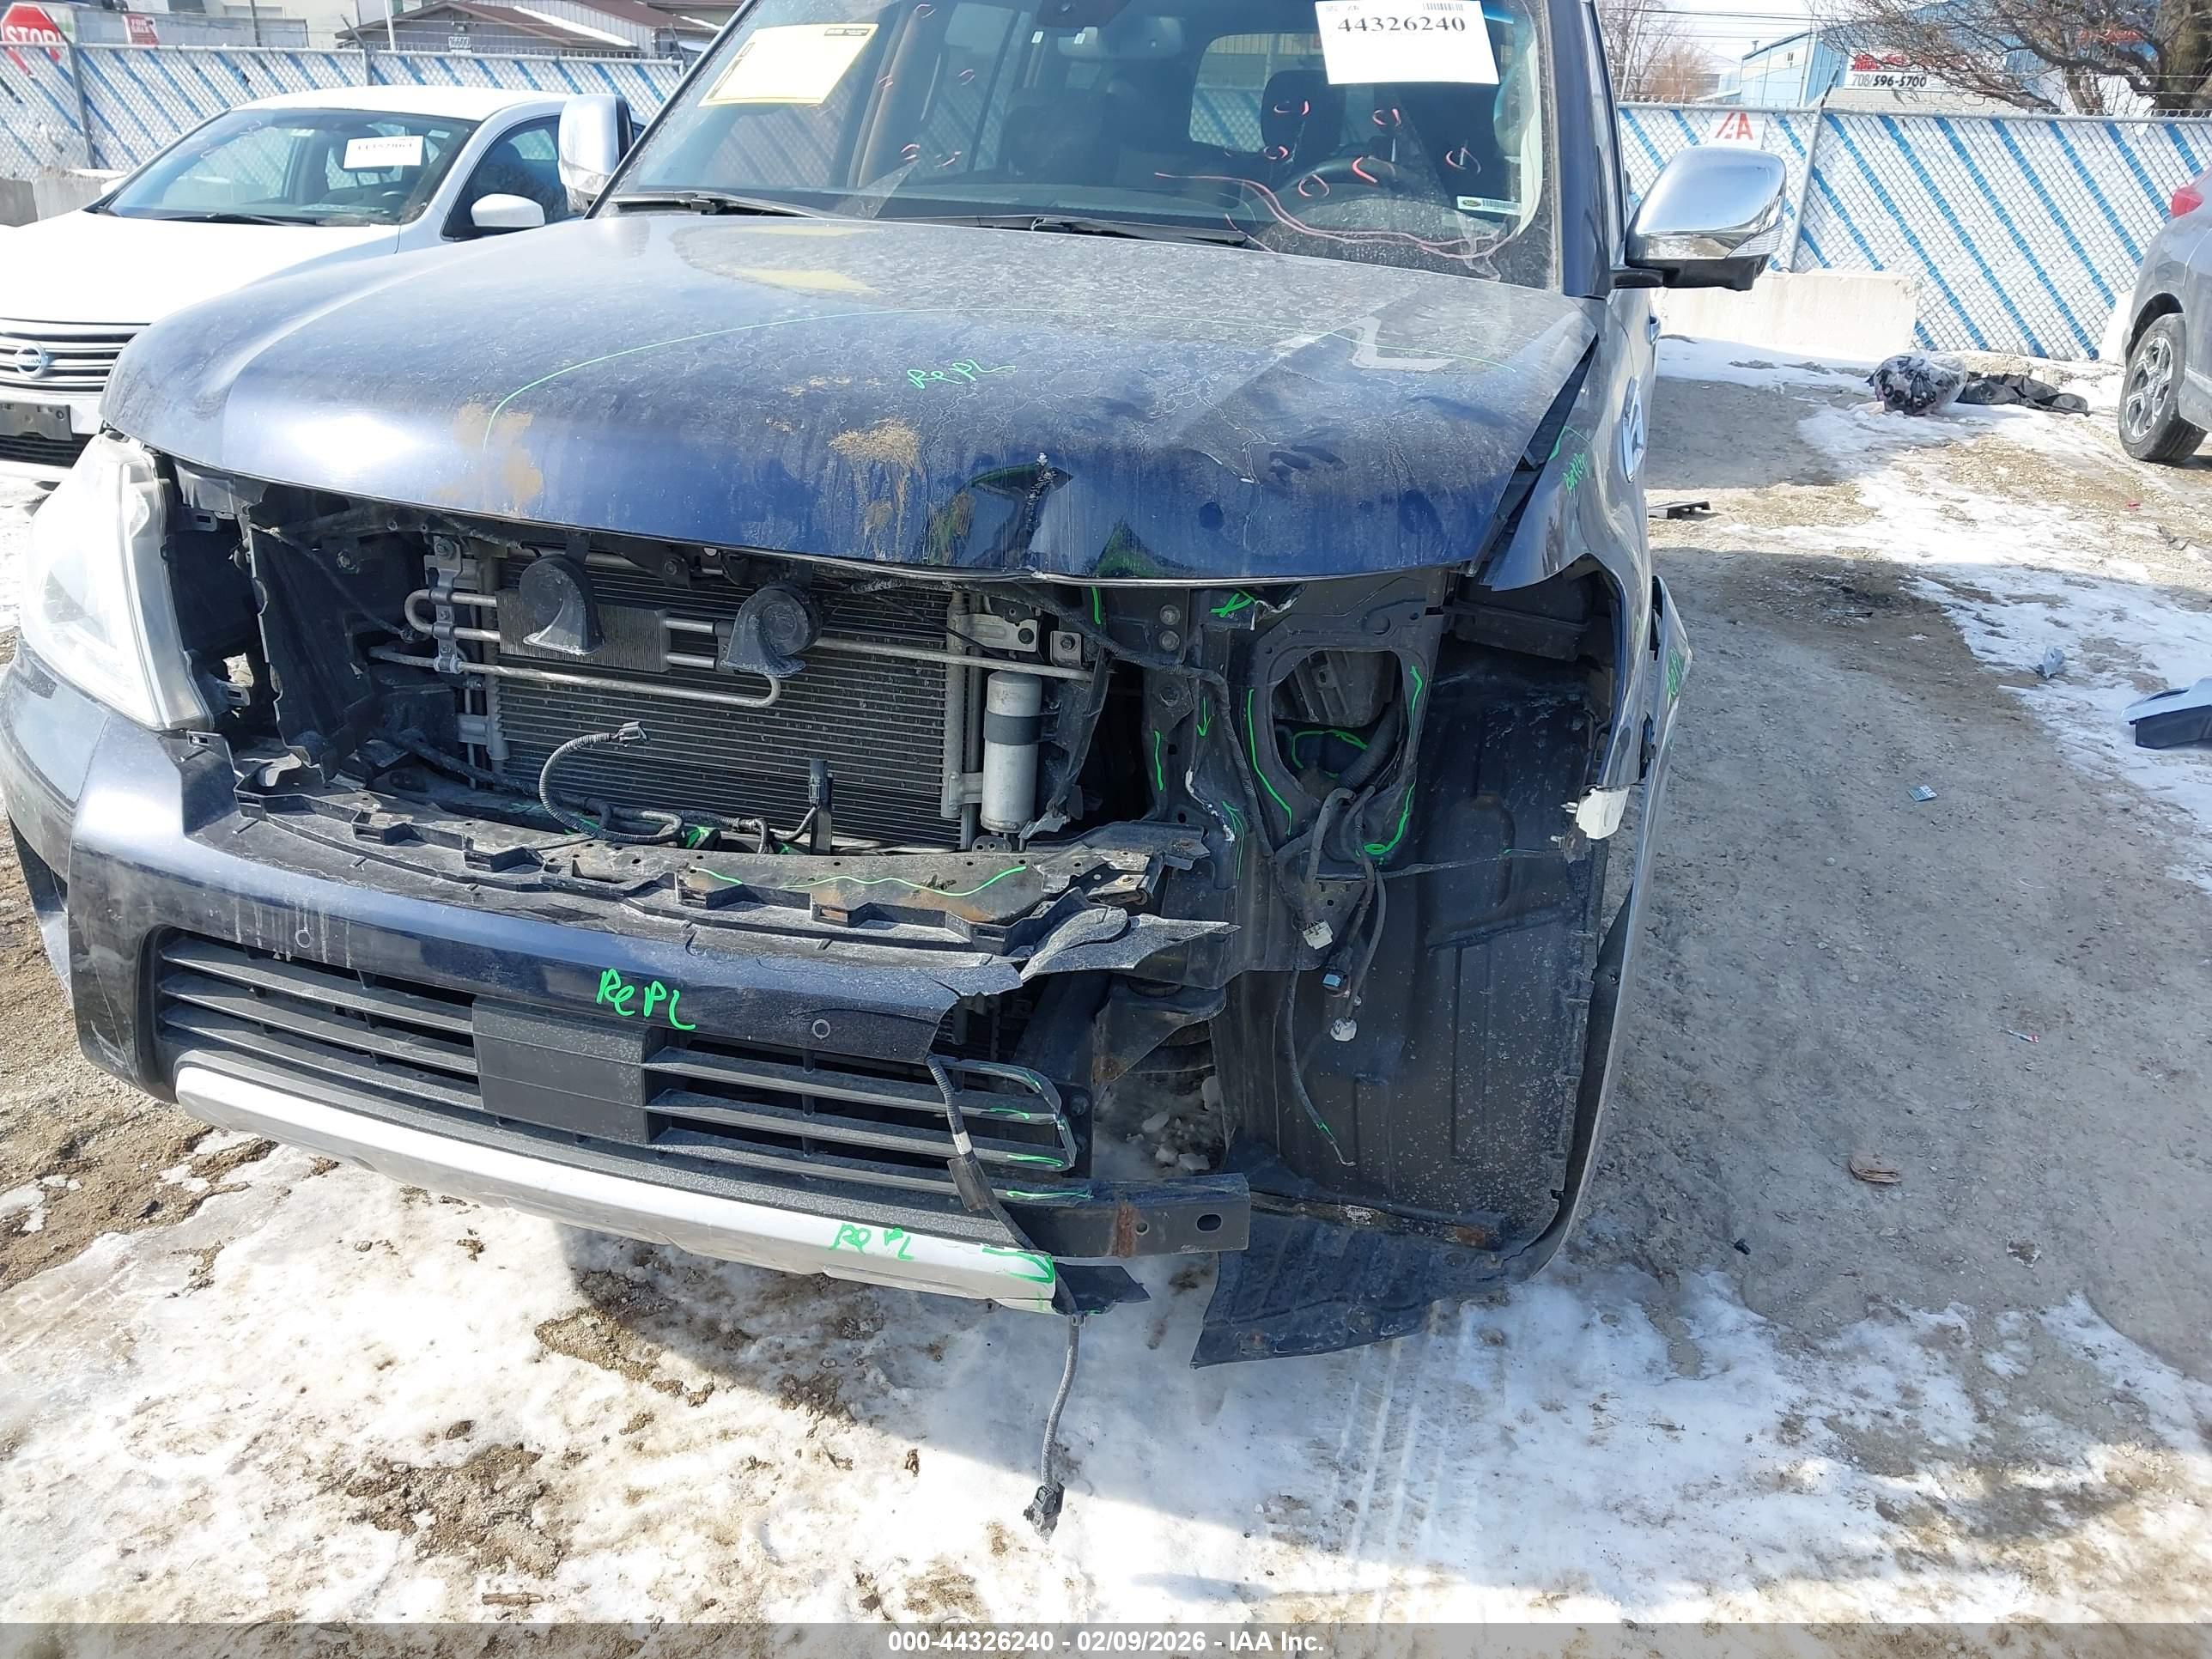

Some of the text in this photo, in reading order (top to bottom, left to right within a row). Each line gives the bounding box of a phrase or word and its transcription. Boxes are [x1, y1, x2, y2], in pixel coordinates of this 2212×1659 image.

[1337, 16, 1466, 32] 44326240
[6, 26, 57, 42] STOP
[1851, 74, 1927, 87] 708/596-5700
